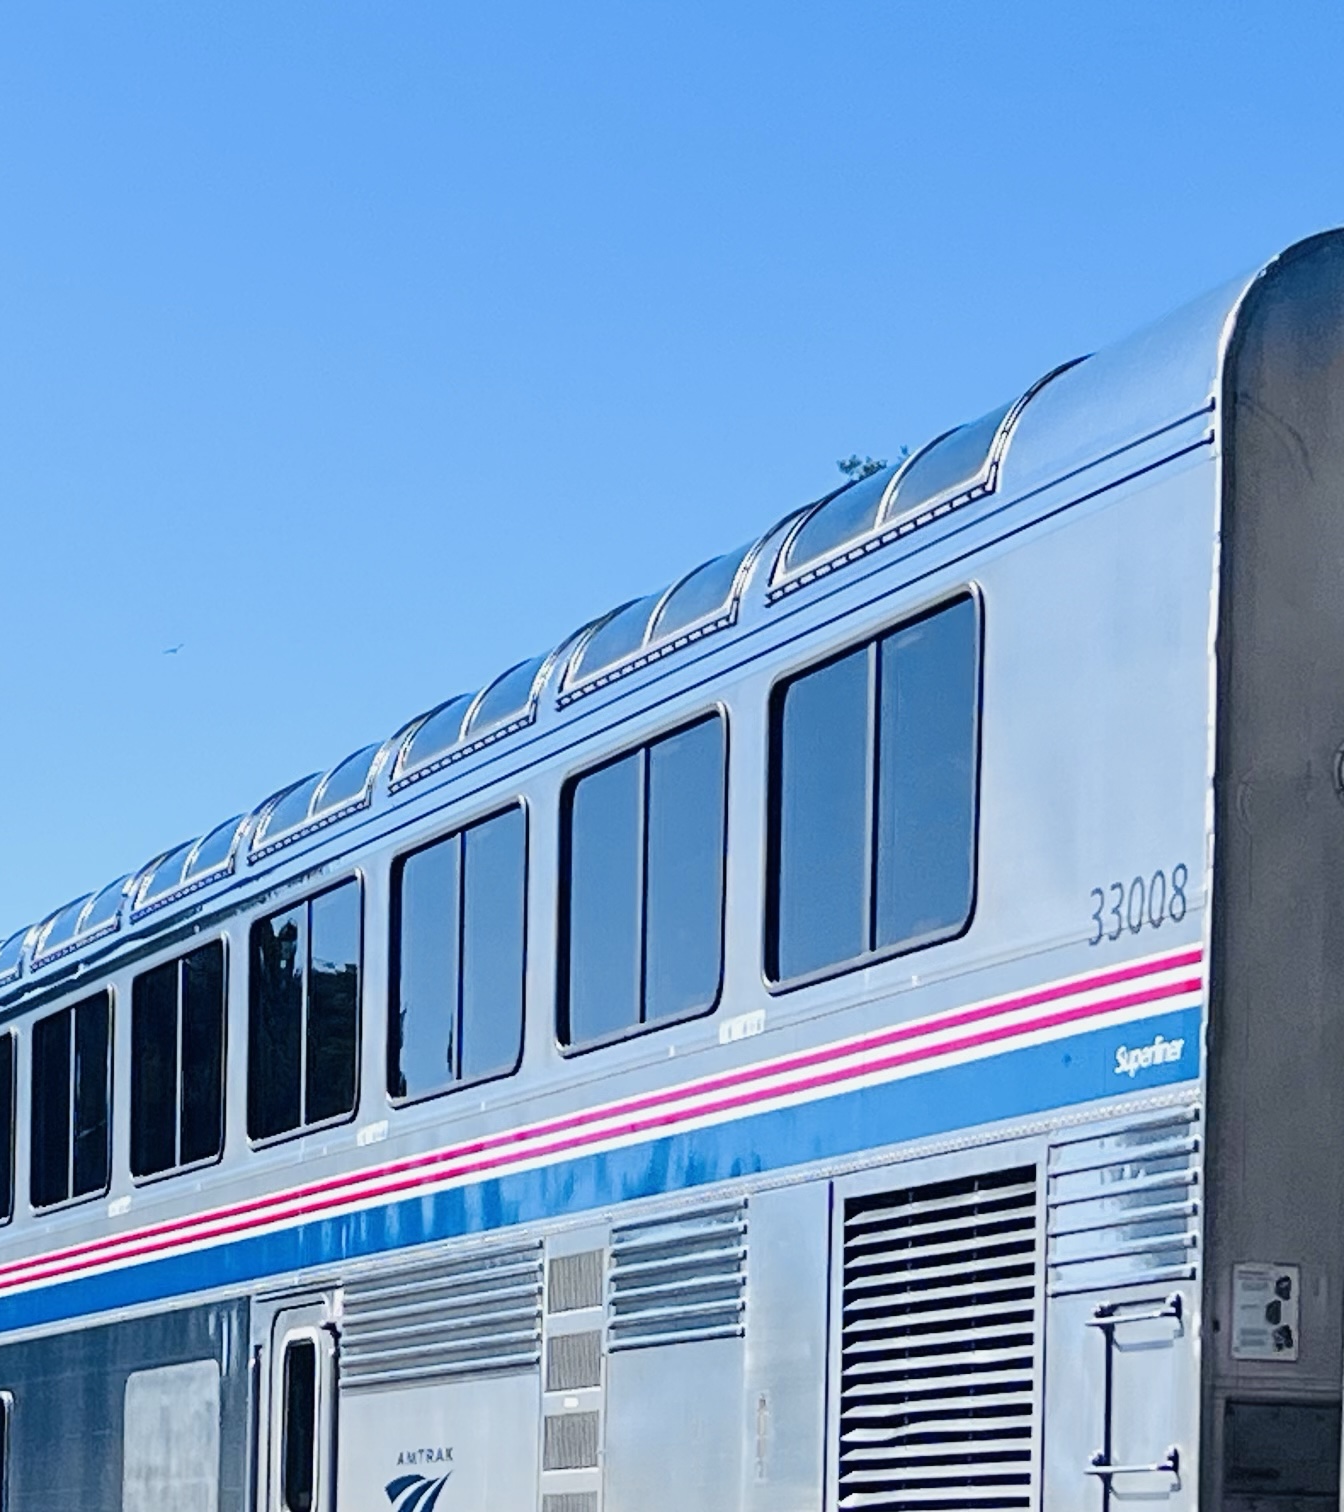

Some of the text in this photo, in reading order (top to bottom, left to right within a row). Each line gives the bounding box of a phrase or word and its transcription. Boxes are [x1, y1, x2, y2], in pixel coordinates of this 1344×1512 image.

[1088, 862, 1188, 946] 33008
[1114, 1035, 1185, 1079] Superliner
[396, 1446, 454, 1466] AMTRAK
